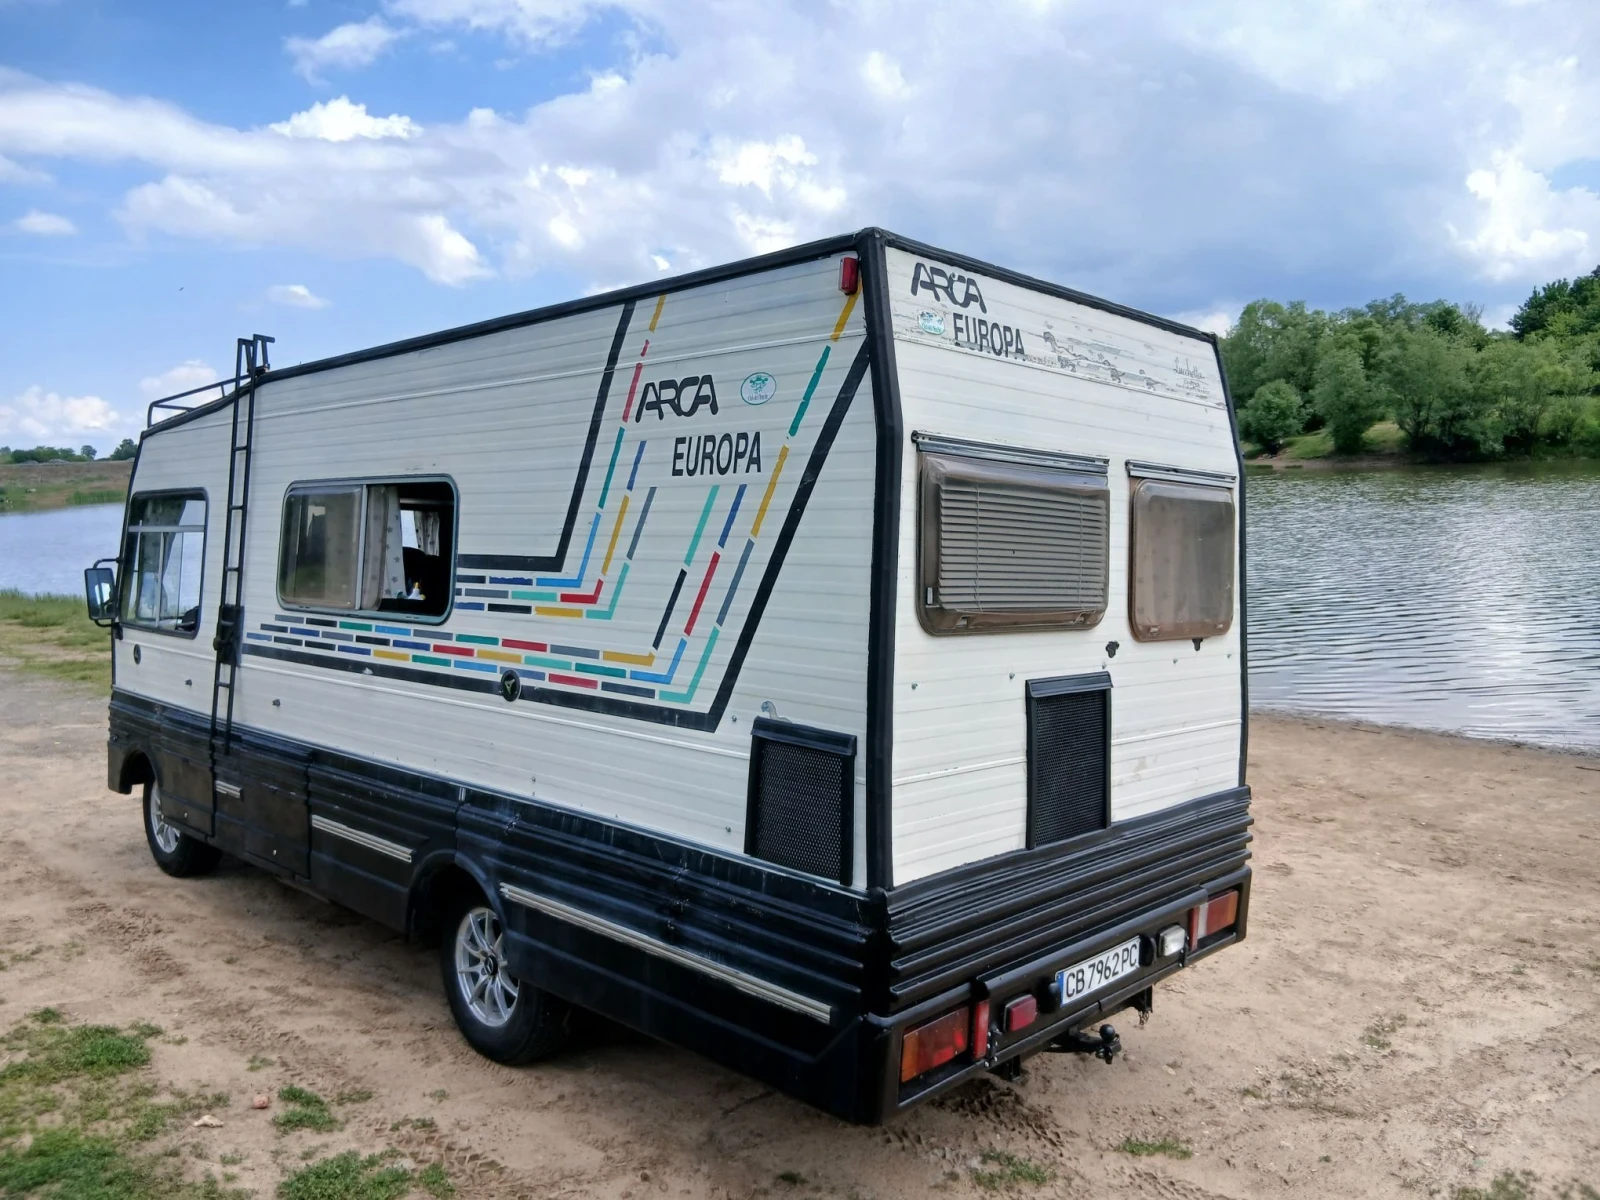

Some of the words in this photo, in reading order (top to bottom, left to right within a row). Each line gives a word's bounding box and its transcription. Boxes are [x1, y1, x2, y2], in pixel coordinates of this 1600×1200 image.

[911, 262, 987, 314] ARCA
[953, 312, 1026, 361] EUROPA
[635, 374, 718, 423] ARCA
[671, 431, 761, 477] EUROPA
